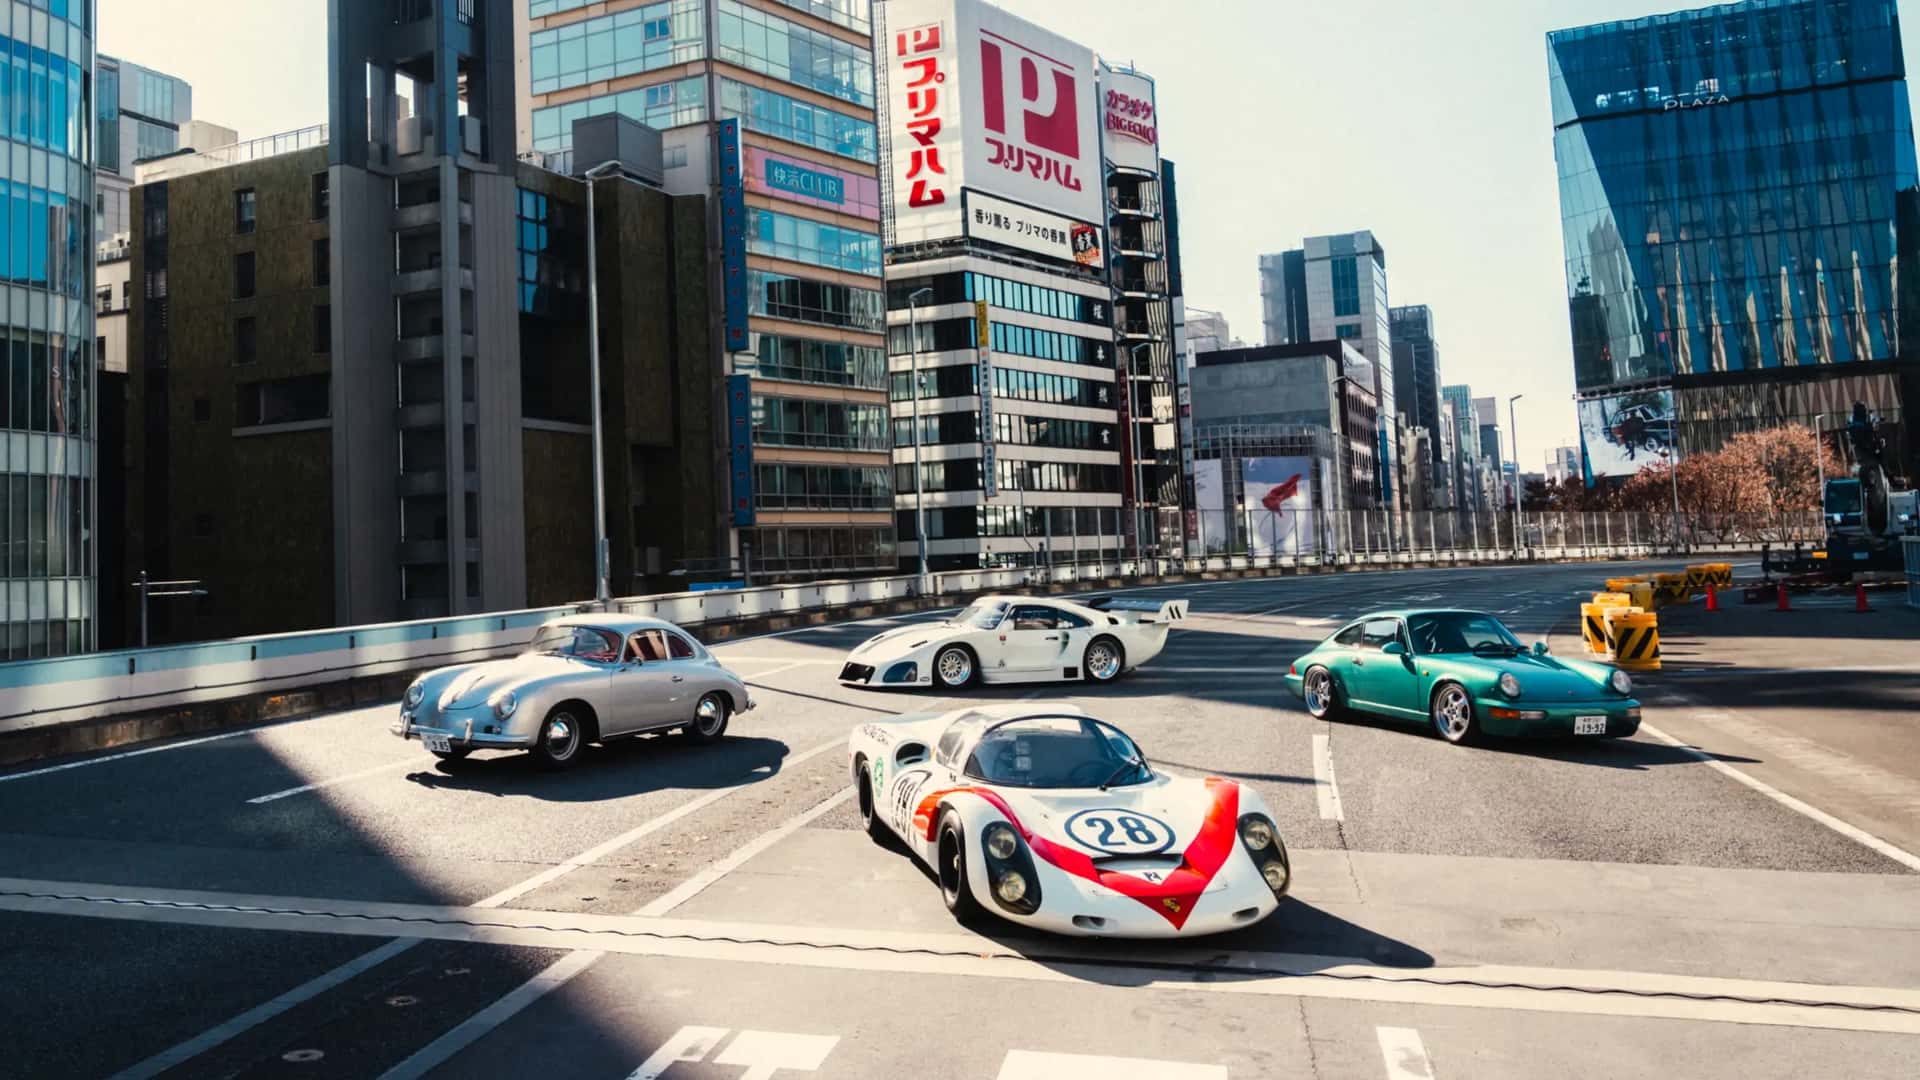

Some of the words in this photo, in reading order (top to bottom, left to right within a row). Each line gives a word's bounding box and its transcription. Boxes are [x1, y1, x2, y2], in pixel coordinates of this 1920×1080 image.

[1106, 89, 1153, 120] カラオケ
[1664, 94, 1730, 110] PLAZA
[902, 56, 946, 208] プリマハム
[985, 136, 1082, 192] プリマハム
[1085, 816, 1157, 846] 28
